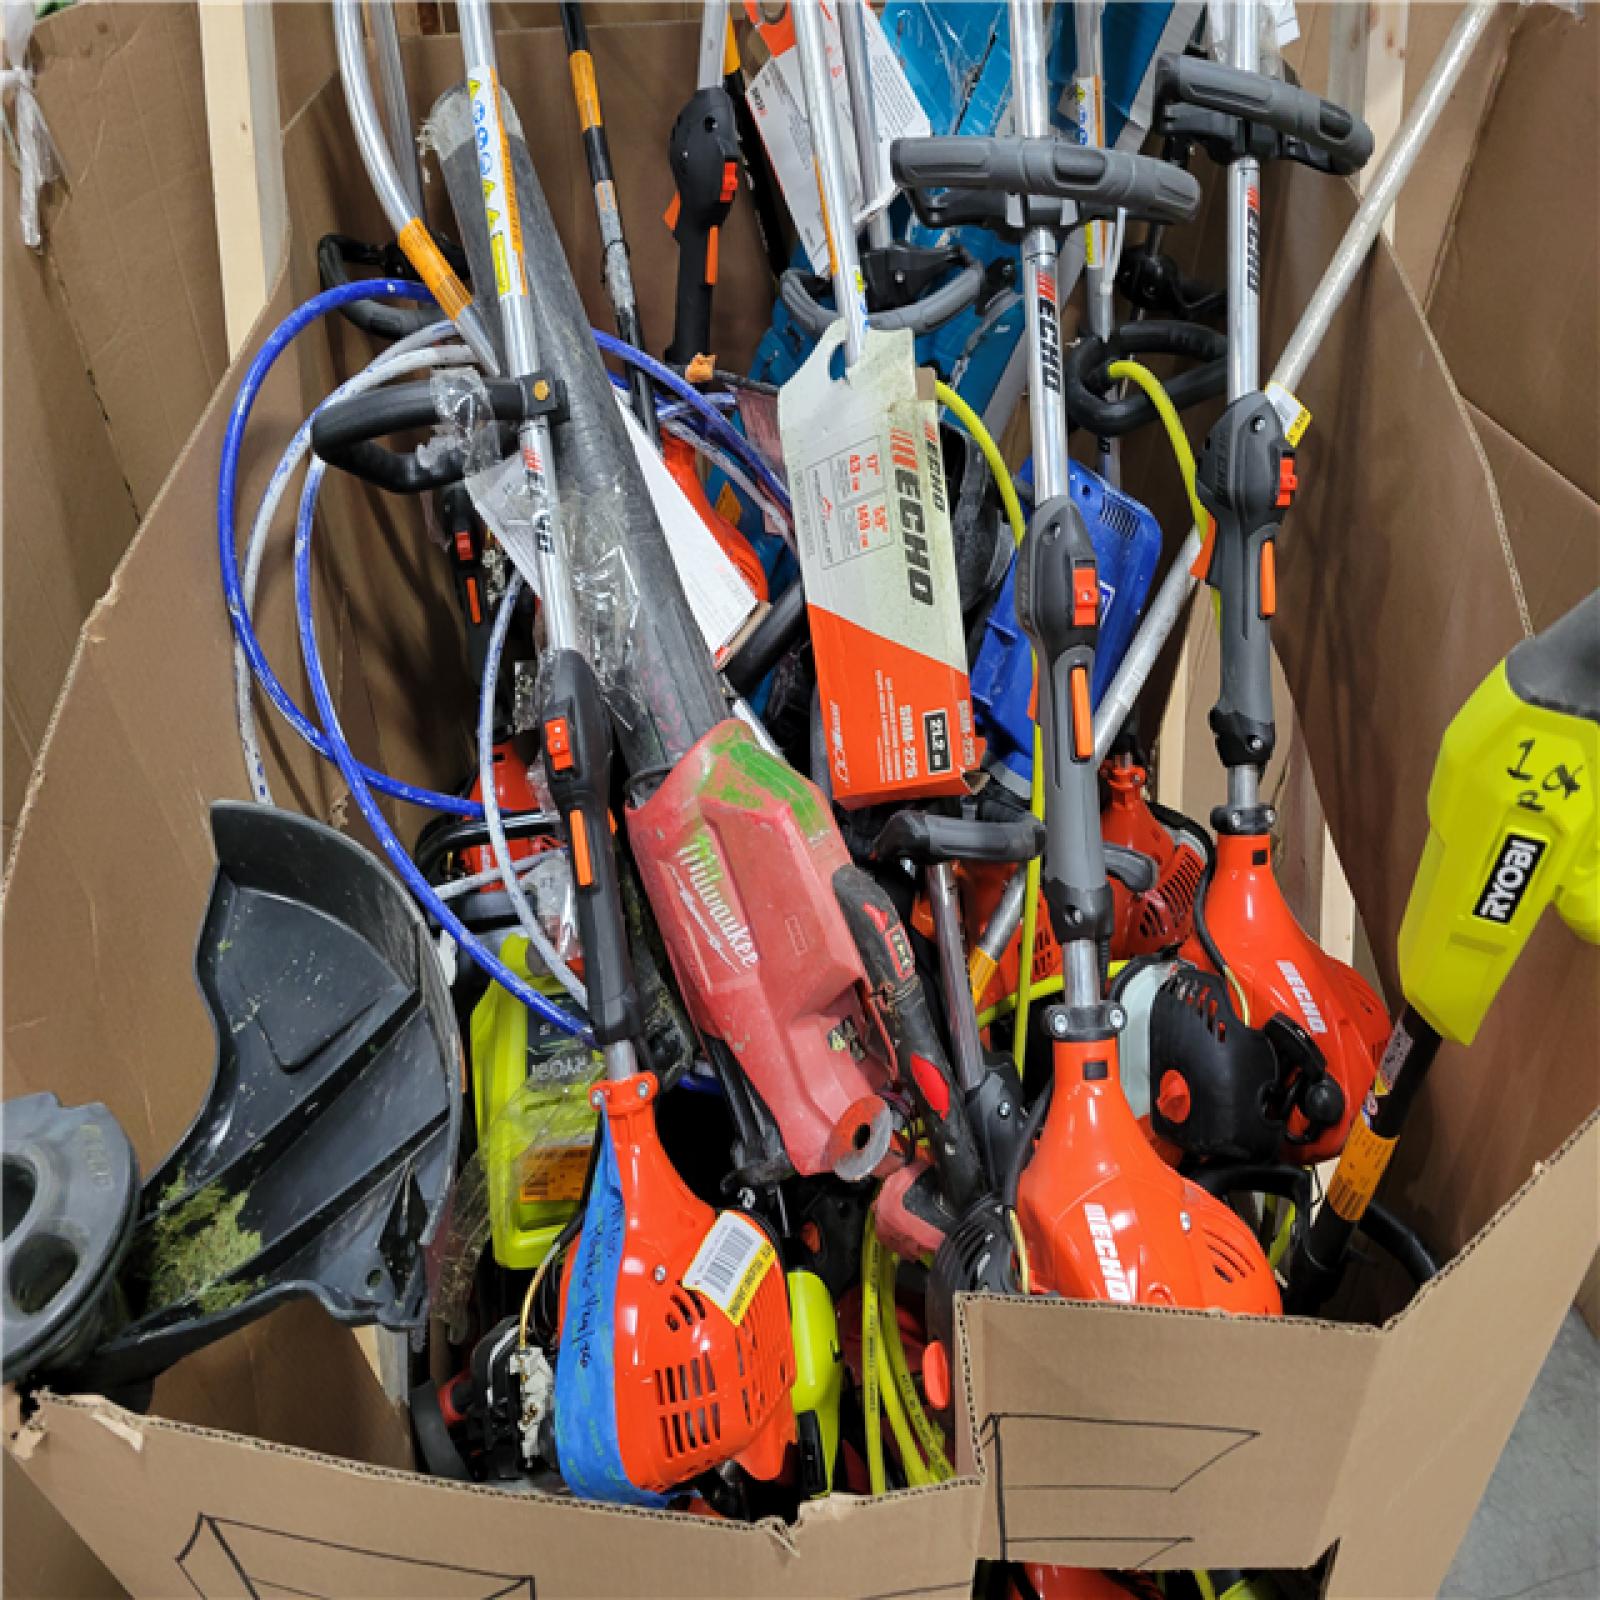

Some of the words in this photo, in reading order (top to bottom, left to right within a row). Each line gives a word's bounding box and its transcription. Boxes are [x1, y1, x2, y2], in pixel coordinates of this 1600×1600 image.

[1037, 297, 1061, 394] ECHO
[895, 469, 934, 606] ECHO
[1480, 838, 1539, 921] RYOBI
[1283, 973, 1328, 1034] ECHO
[1088, 1223, 1131, 1303] ECHO
